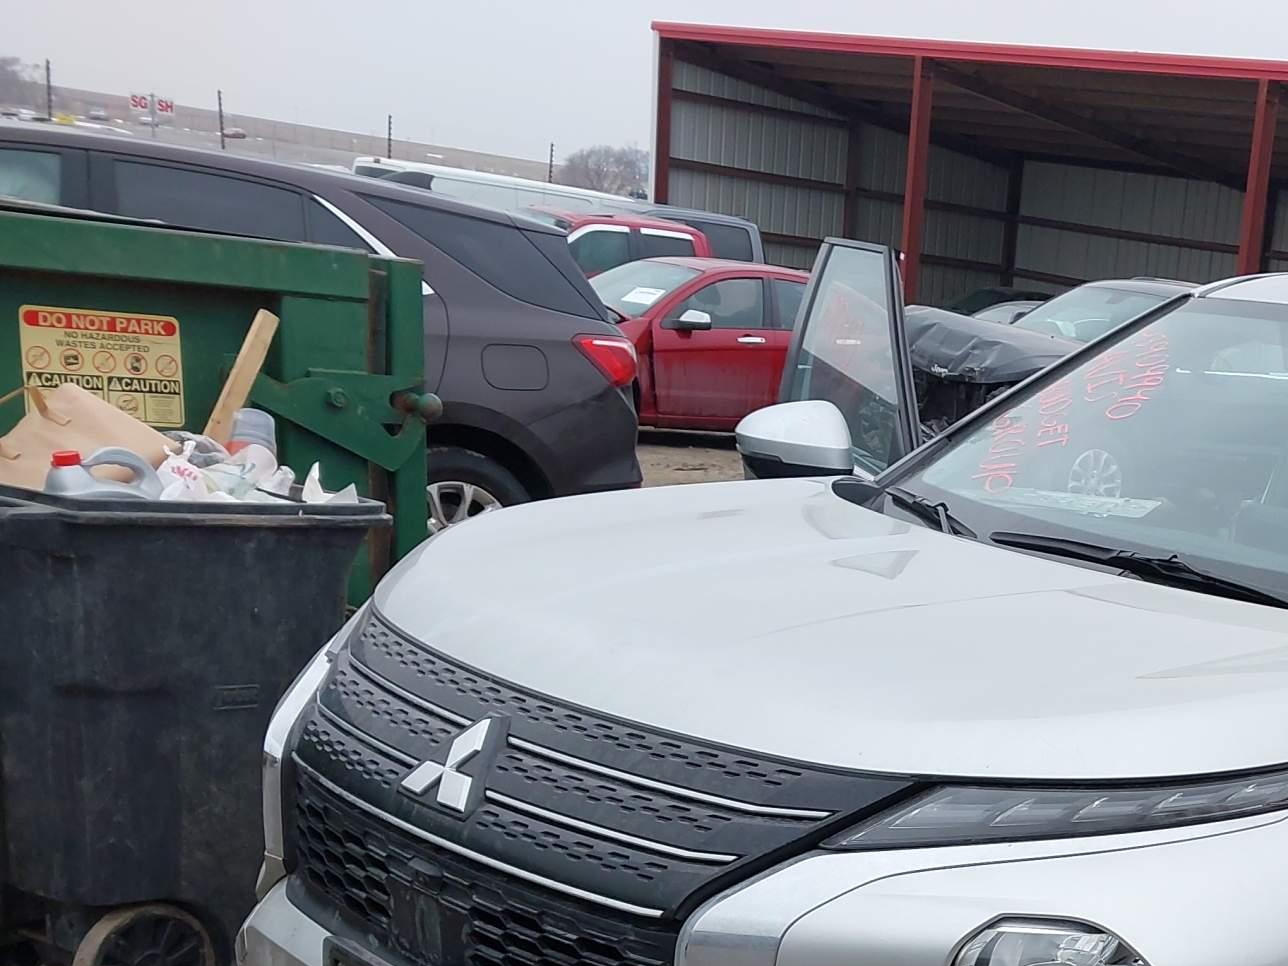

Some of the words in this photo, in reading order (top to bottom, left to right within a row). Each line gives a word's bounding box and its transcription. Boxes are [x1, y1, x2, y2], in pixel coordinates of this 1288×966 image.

[37, 311, 67, 328] DO
[71, 314, 113, 331] NOT
[115, 317, 166, 335] PARK
[56, 339, 97, 350] WASTES
[99, 343, 150, 353] ACCEPTED
[63, 331, 79, 339] NO
[81, 331, 141, 344] HAZARDOUS
[41, 373, 103, 389] CAUTION
[121, 376, 180, 394] CAUTION
[1037, 376, 1073, 448] DGET
